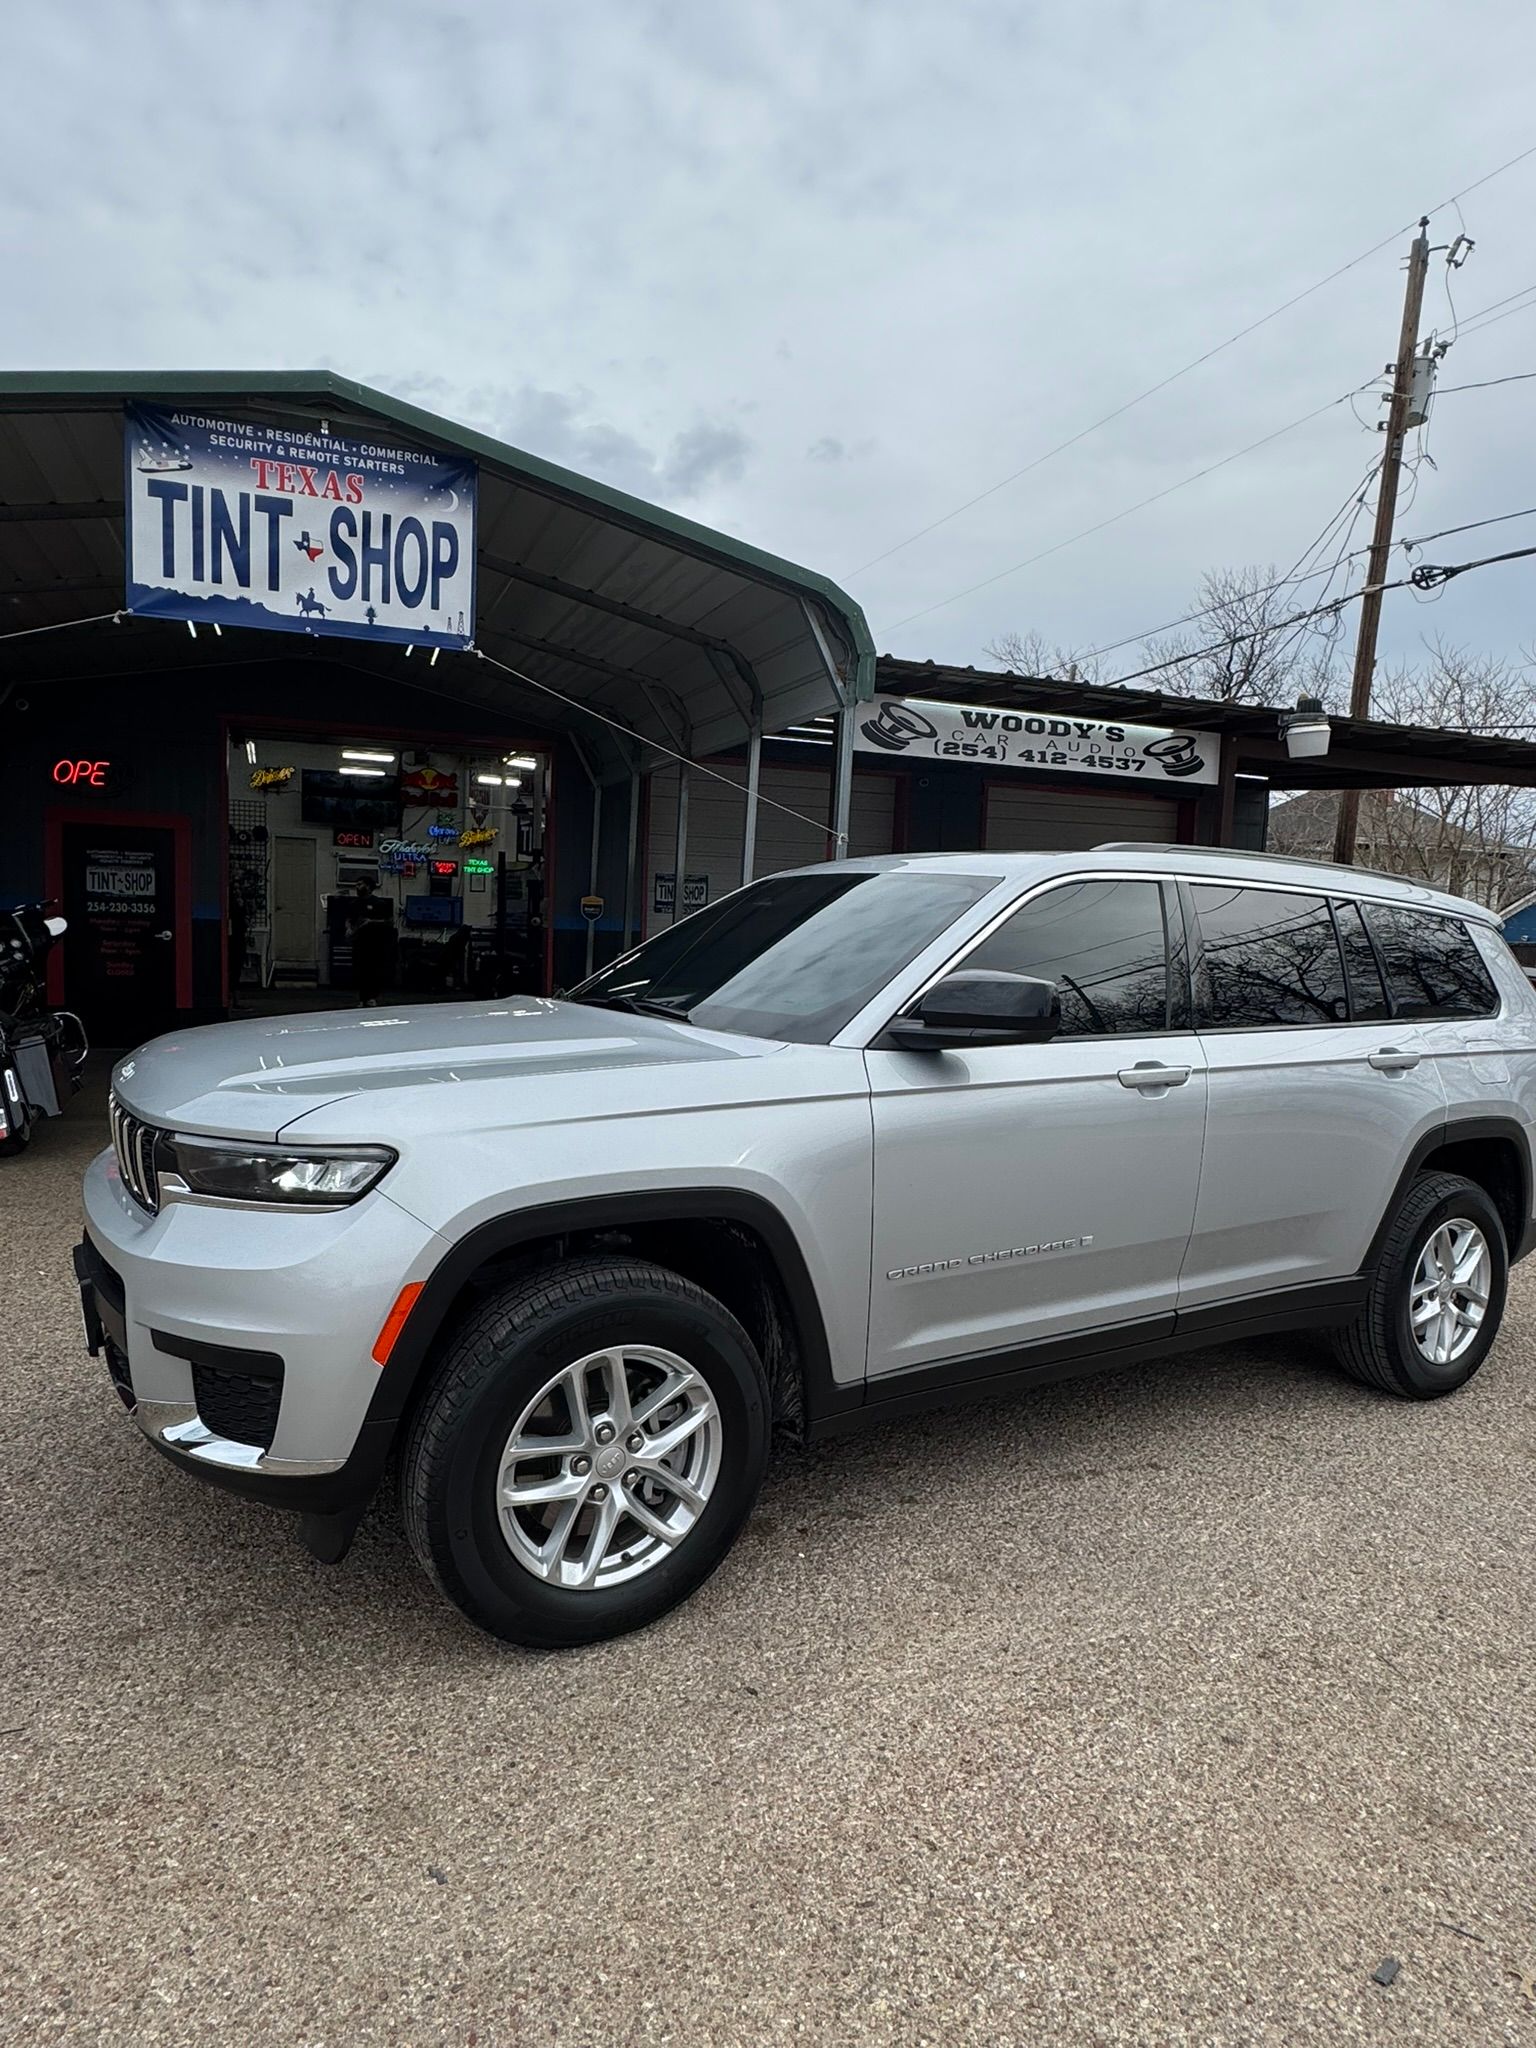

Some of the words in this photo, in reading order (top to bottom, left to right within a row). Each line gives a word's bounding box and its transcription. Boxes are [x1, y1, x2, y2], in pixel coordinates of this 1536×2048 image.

[171, 413, 254, 437] AUTOMOTIVE
[266, 429, 350, 453] RESIDENTIAL
[360, 444, 439, 467] COMMERCIAL
[209, 434, 272, 455] SECURITY
[276, 445, 285, 457] &
[289, 447, 339, 465] REMOTE
[343, 456, 405, 475] STARTERS
[250, 458, 364, 505] TEXAS
[147, 478, 293, 592] TINT
[327, 505, 459, 611] SHOP
[960, 710, 1125, 743] WOODY'S
[933, 739, 1007, 762] (254)
[1017, 749, 1146, 773] 412-4537
[952, 730, 1009, 746] CAR
[1046, 740, 1136, 758] AUDIO
[336, 833, 371, 847] OPEN
[393, 852, 427, 862] ULTRA
[89, 872, 117, 890] TINT
[125, 872, 153, 891] SHOP
[658, 885, 674, 900] TIN
[683, 885, 705, 900] SHOP
[87, 901, 156, 914] 254-230-3356
[886, 1258, 963, 1281] GRAND
[968, 1238, 1076, 1266] CHEROKEE
